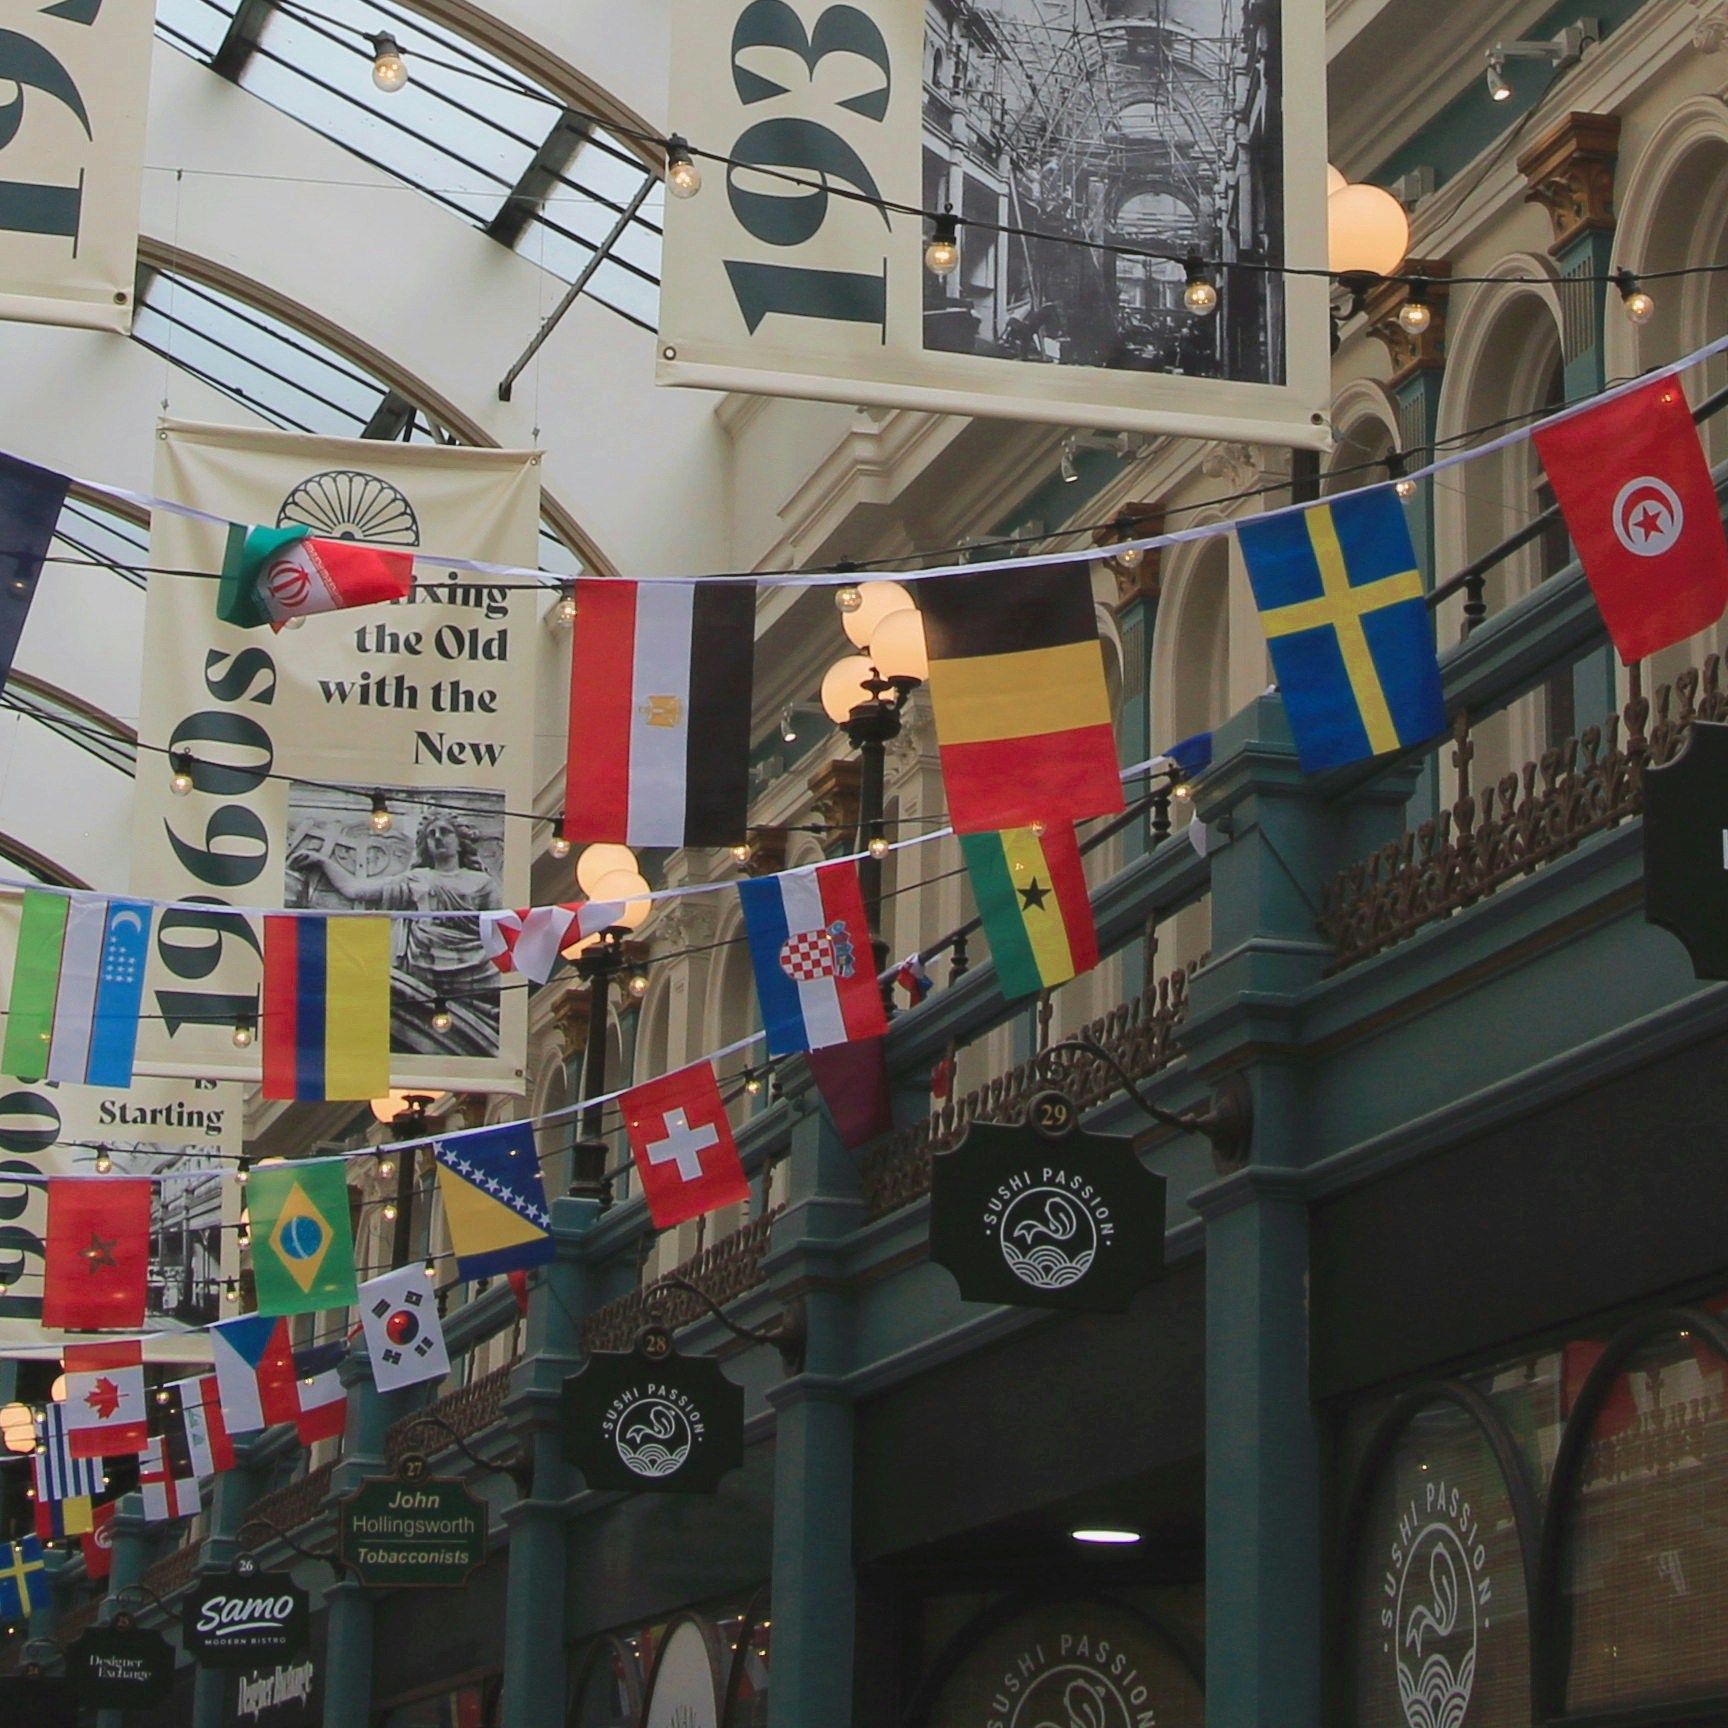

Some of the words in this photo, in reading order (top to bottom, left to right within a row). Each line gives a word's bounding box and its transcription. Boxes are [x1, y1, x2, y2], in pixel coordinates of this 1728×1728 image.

[390, 571, 510, 619] ixing
[354, 624, 423, 656] the
[434, 626, 509, 662] Old
[318, 672, 418, 712] with
[430, 680, 498, 714] the
[413, 730, 509, 769] New
[154, 646, 276, 1042] 1960s
[98, 1099, 225, 1136] Starting
[1040, 1105, 1067, 1125] 29
[983, 1171, 1032, 1225] SUSHI
[1043, 1168, 1115, 1236] PASSION
[646, 1335, 667, 1352] 28
[602, 1387, 639, 1431] SUSHI
[648, 1384, 705, 1433] PASSION
[388, 1491, 440, 1509] John
[353, 1516, 475, 1538] Hollingsworth
[239, 1560, 254, 1572] 26
[358, 1548, 470, 1565] Tobacconists
[1382, 1500, 1418, 1629] SUSHI
[1426, 1481, 1491, 1605] PASSION
[196, 1595, 294, 1632] Samo
[90, 1655, 143, 1670] Designer
[1061, 1634, 1157, 1728] PASSION
